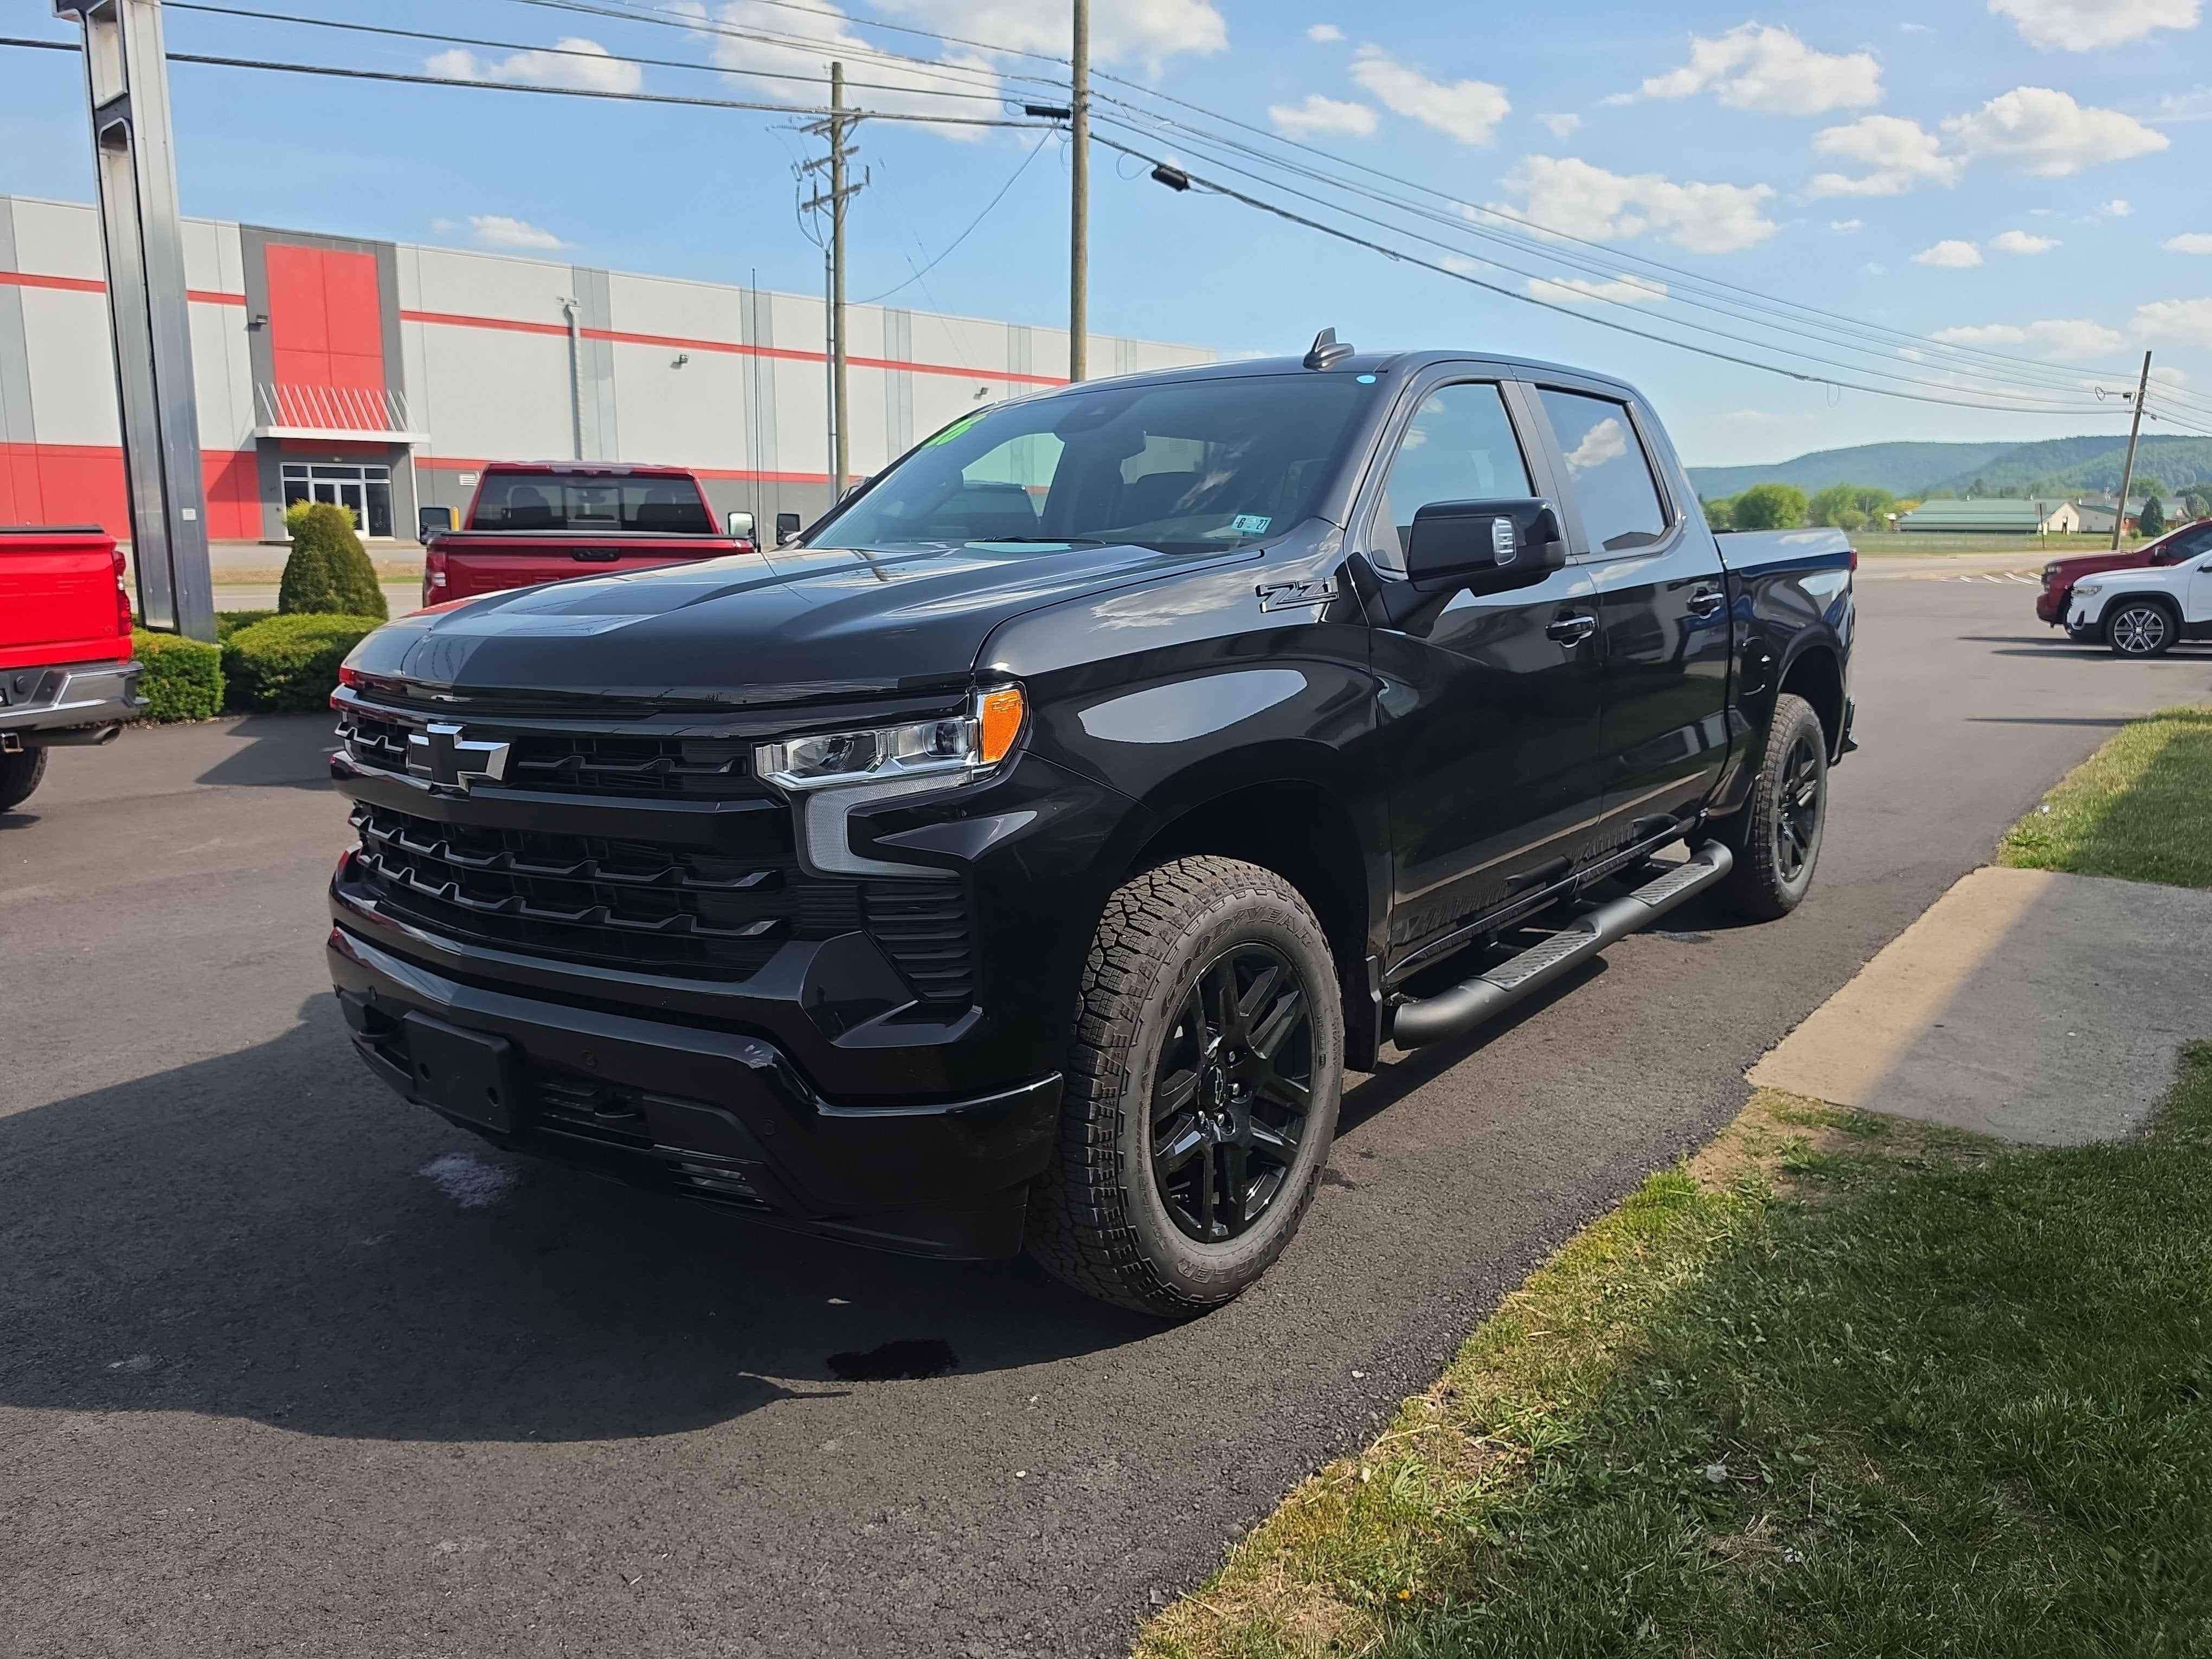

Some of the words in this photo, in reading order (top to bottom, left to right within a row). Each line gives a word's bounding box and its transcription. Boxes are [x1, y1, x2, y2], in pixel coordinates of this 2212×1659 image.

[1237, 517, 1246, 529] 6
[1256, 519, 1268, 530] 27
[1256, 575, 1340, 614] Z71
[1161, 906, 1315, 1019] GOODYEAR
[1178, 1163, 1321, 1284] WRANGLER
